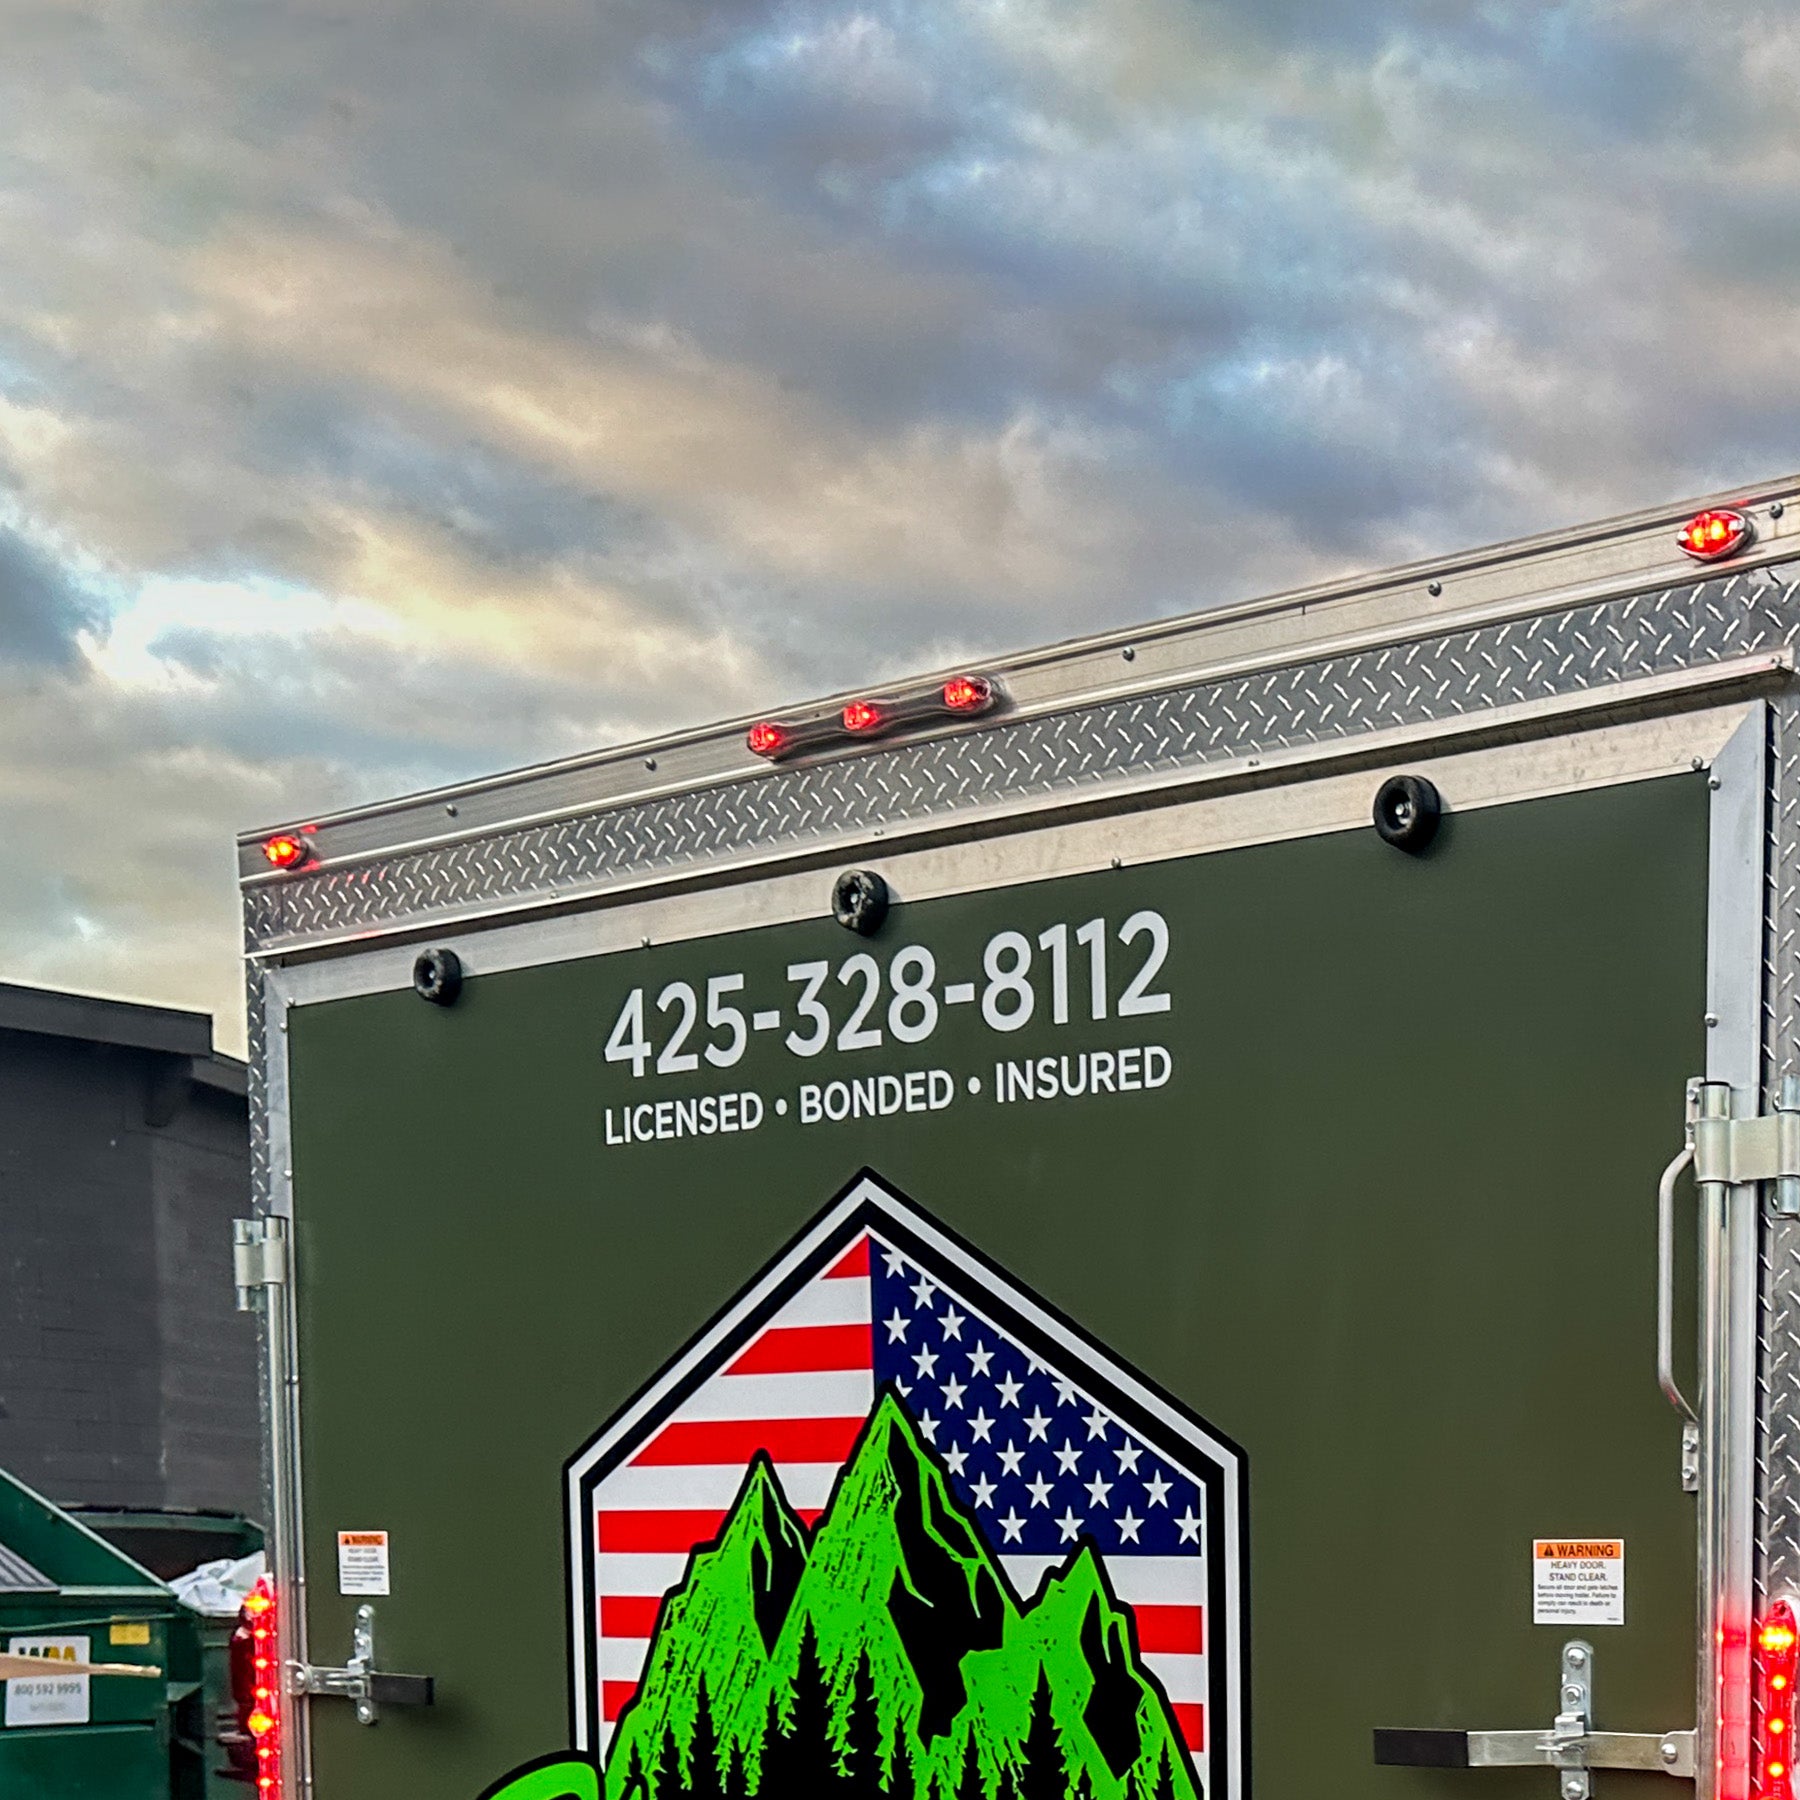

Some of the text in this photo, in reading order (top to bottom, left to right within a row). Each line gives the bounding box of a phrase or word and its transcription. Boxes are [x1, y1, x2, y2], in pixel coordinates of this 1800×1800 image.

[603, 909, 1172, 1078] 425-328-8112
[605, 1045, 1173, 1146] LICENSED BONDED INSURED
[1557, 1544, 1614, 1557] WARNING
[1551, 1561, 1606, 1569] HEAVY DOOR.
[1549, 1573, 1607, 1581] STAND CLEAR.
